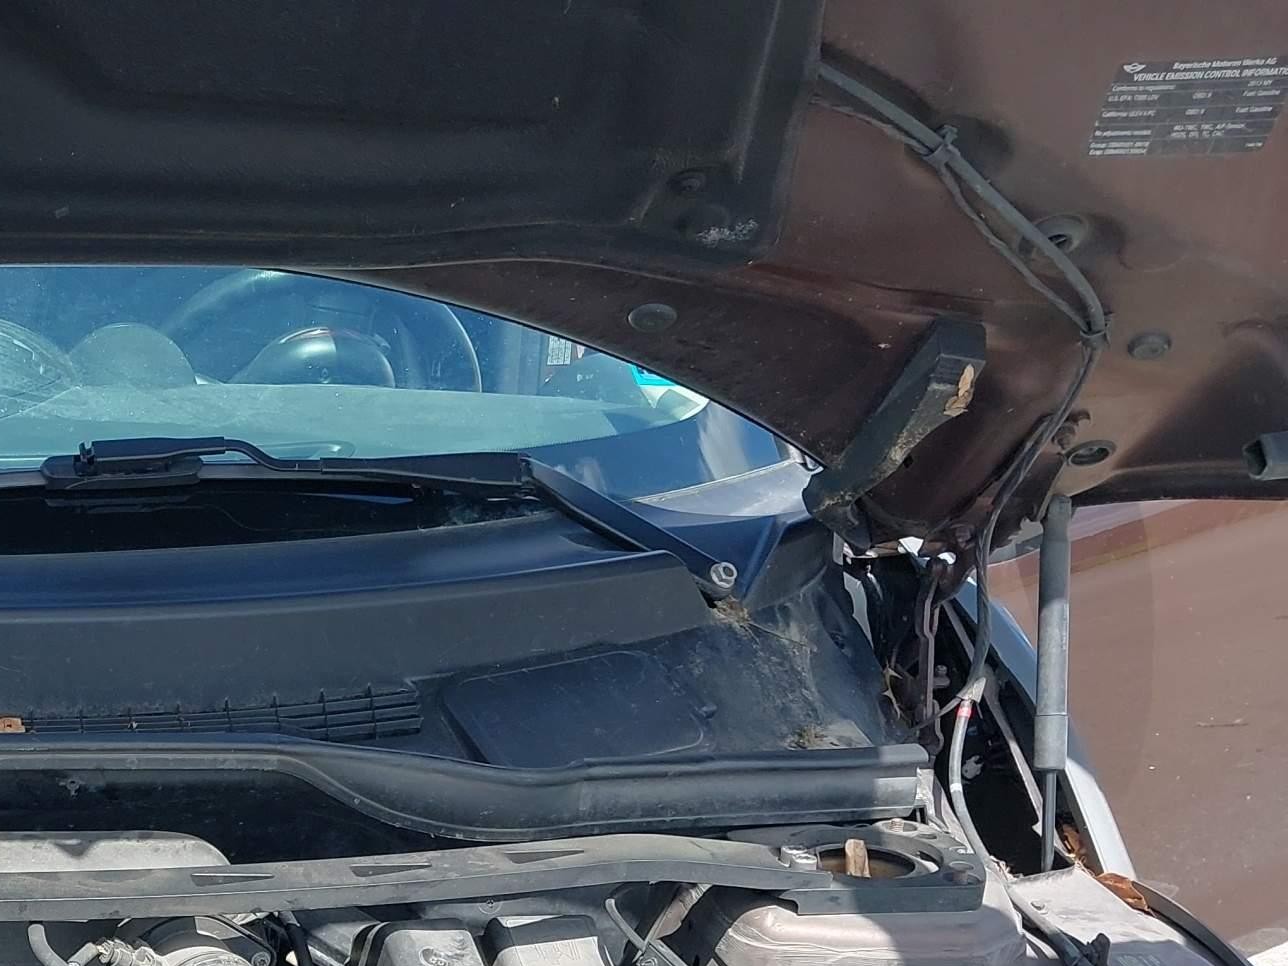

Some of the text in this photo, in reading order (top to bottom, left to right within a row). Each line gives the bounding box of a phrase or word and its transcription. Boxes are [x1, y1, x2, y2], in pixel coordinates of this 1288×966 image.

[1134, 73, 1164, 81] VEHICLE
[1165, 71, 1204, 80] EMISSION
[1204, 70, 1240, 78] CONTROL
